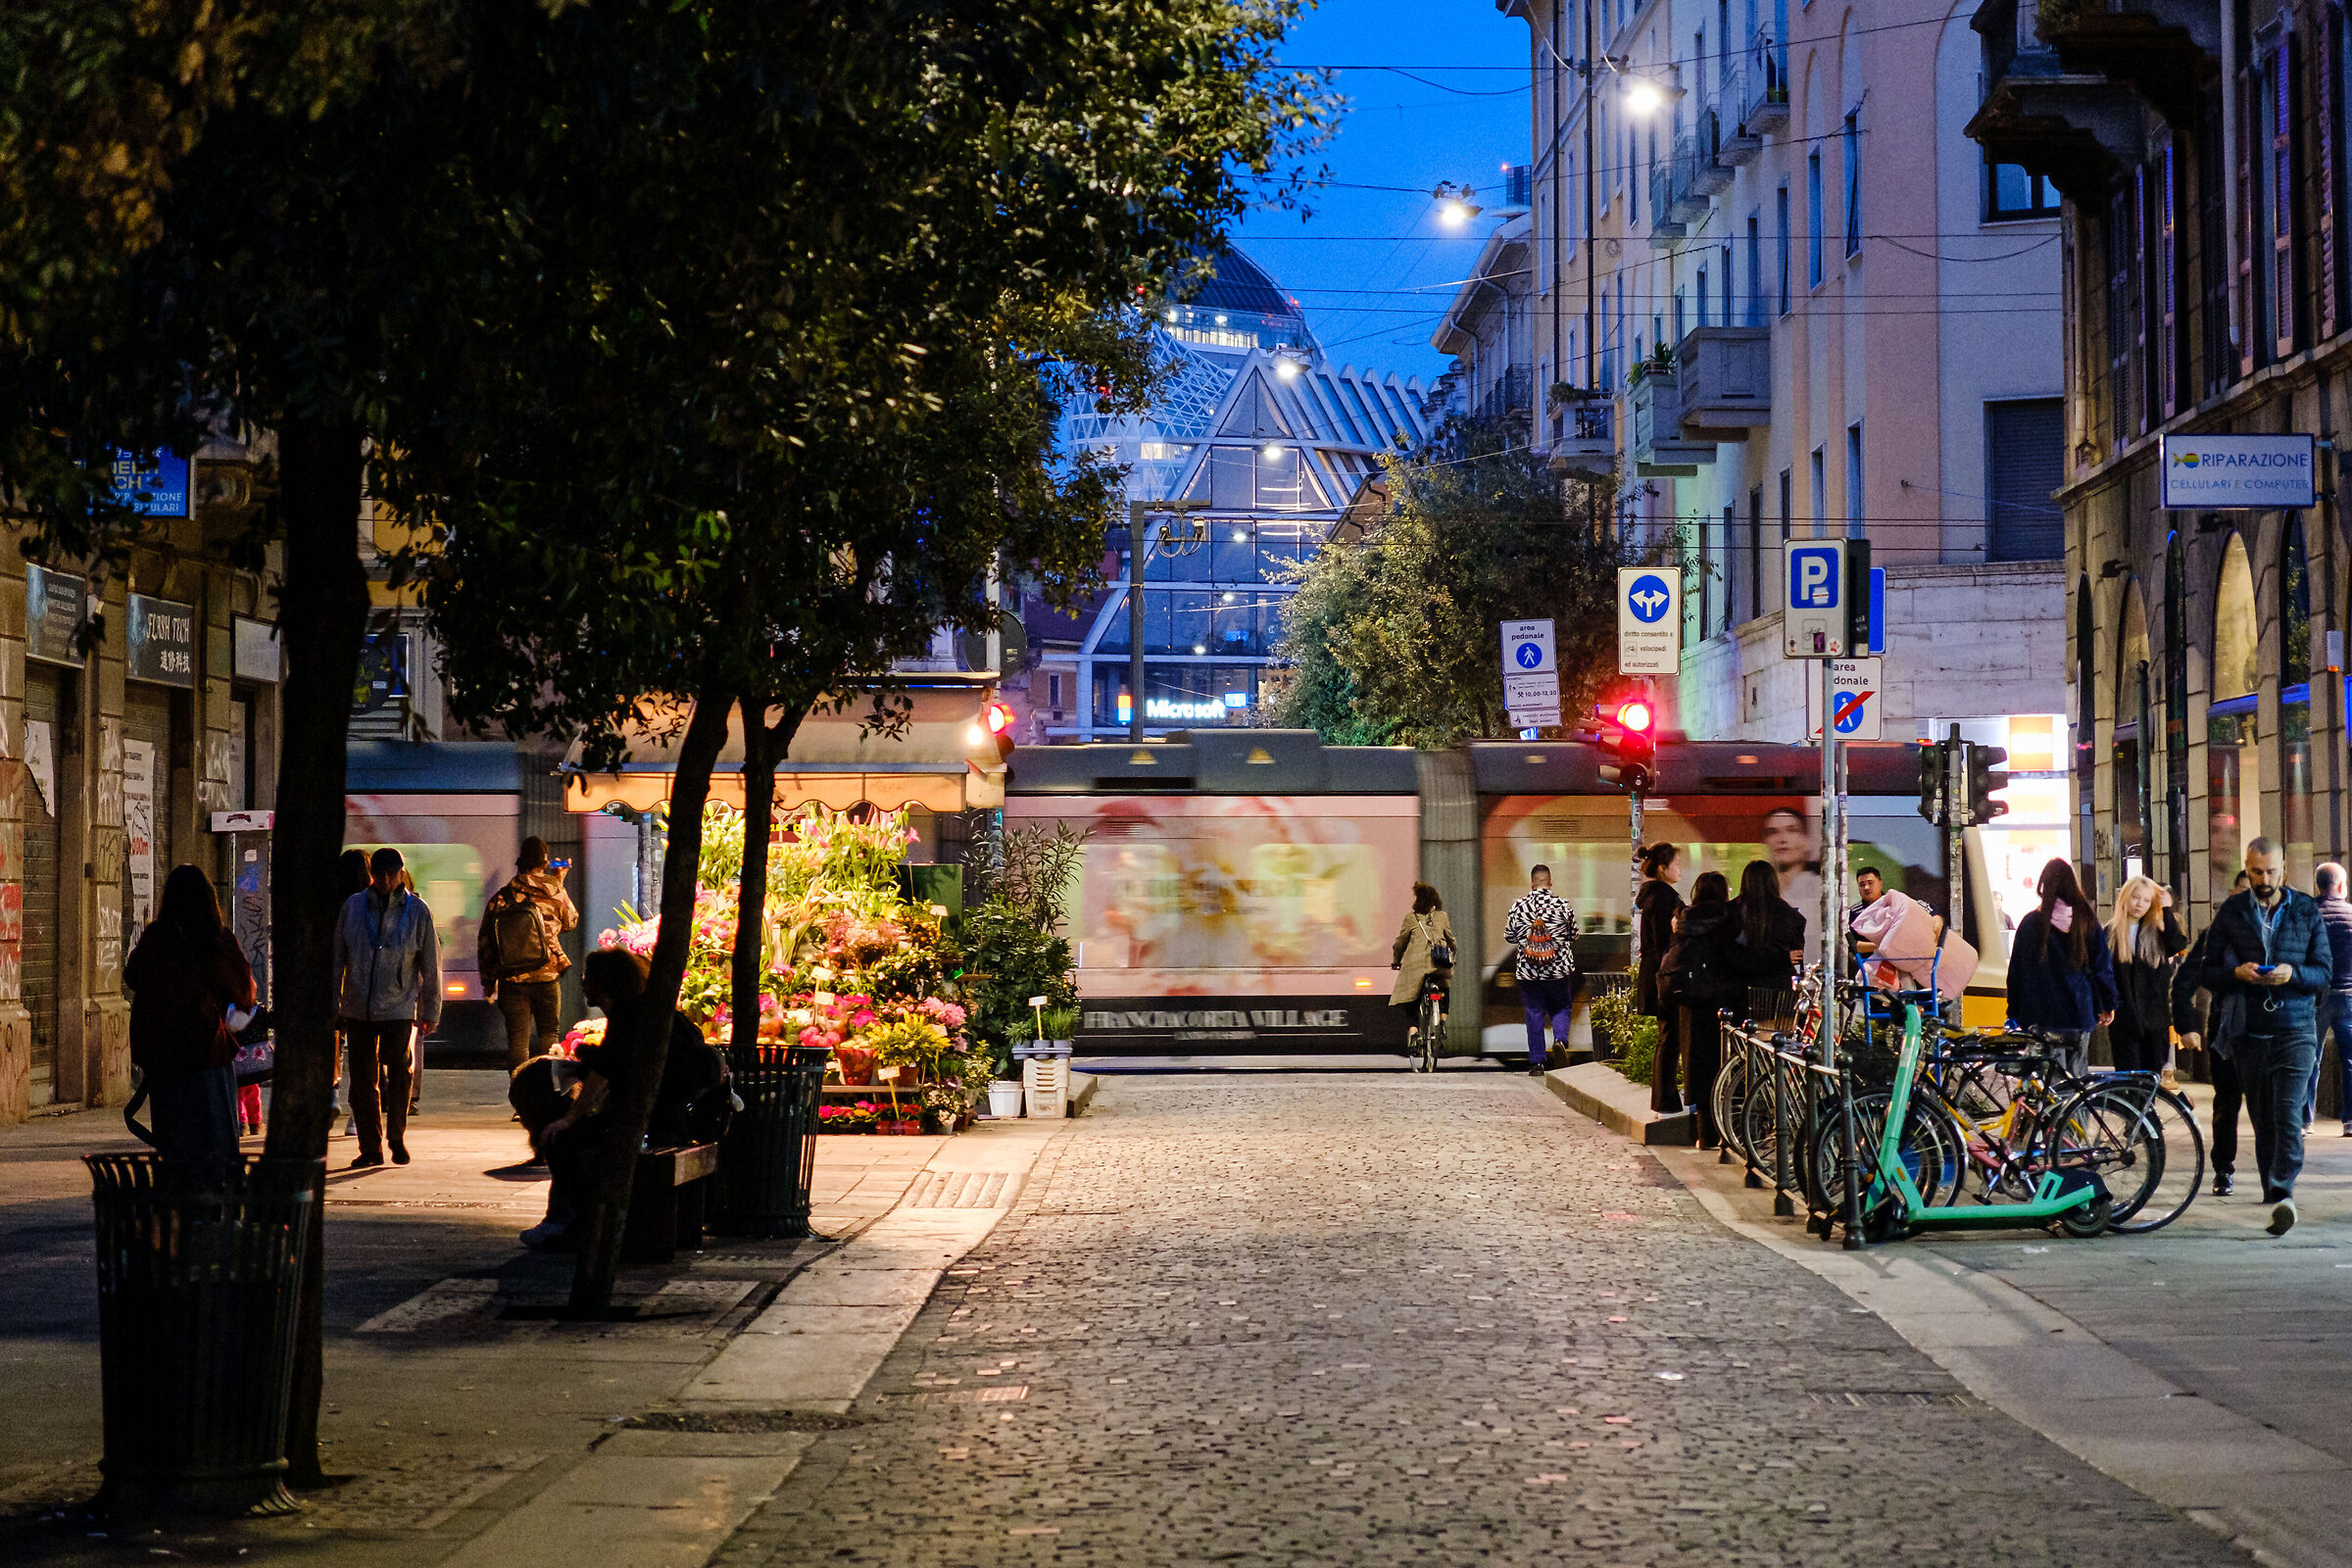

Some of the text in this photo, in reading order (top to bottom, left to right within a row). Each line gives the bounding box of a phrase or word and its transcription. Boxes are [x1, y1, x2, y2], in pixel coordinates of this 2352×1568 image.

[2202, 453, 2308, 467] RIPARAZIONE
[2171, 479, 2230, 490] CELLULARI
[2244, 479, 2309, 490] COMPUTER
[1511, 632, 1544, 641] pedonale
[1834, 662, 1856, 671] area
[1834, 676, 1869, 686] donale
[1146, 698, 1225, 718] Microsoft
